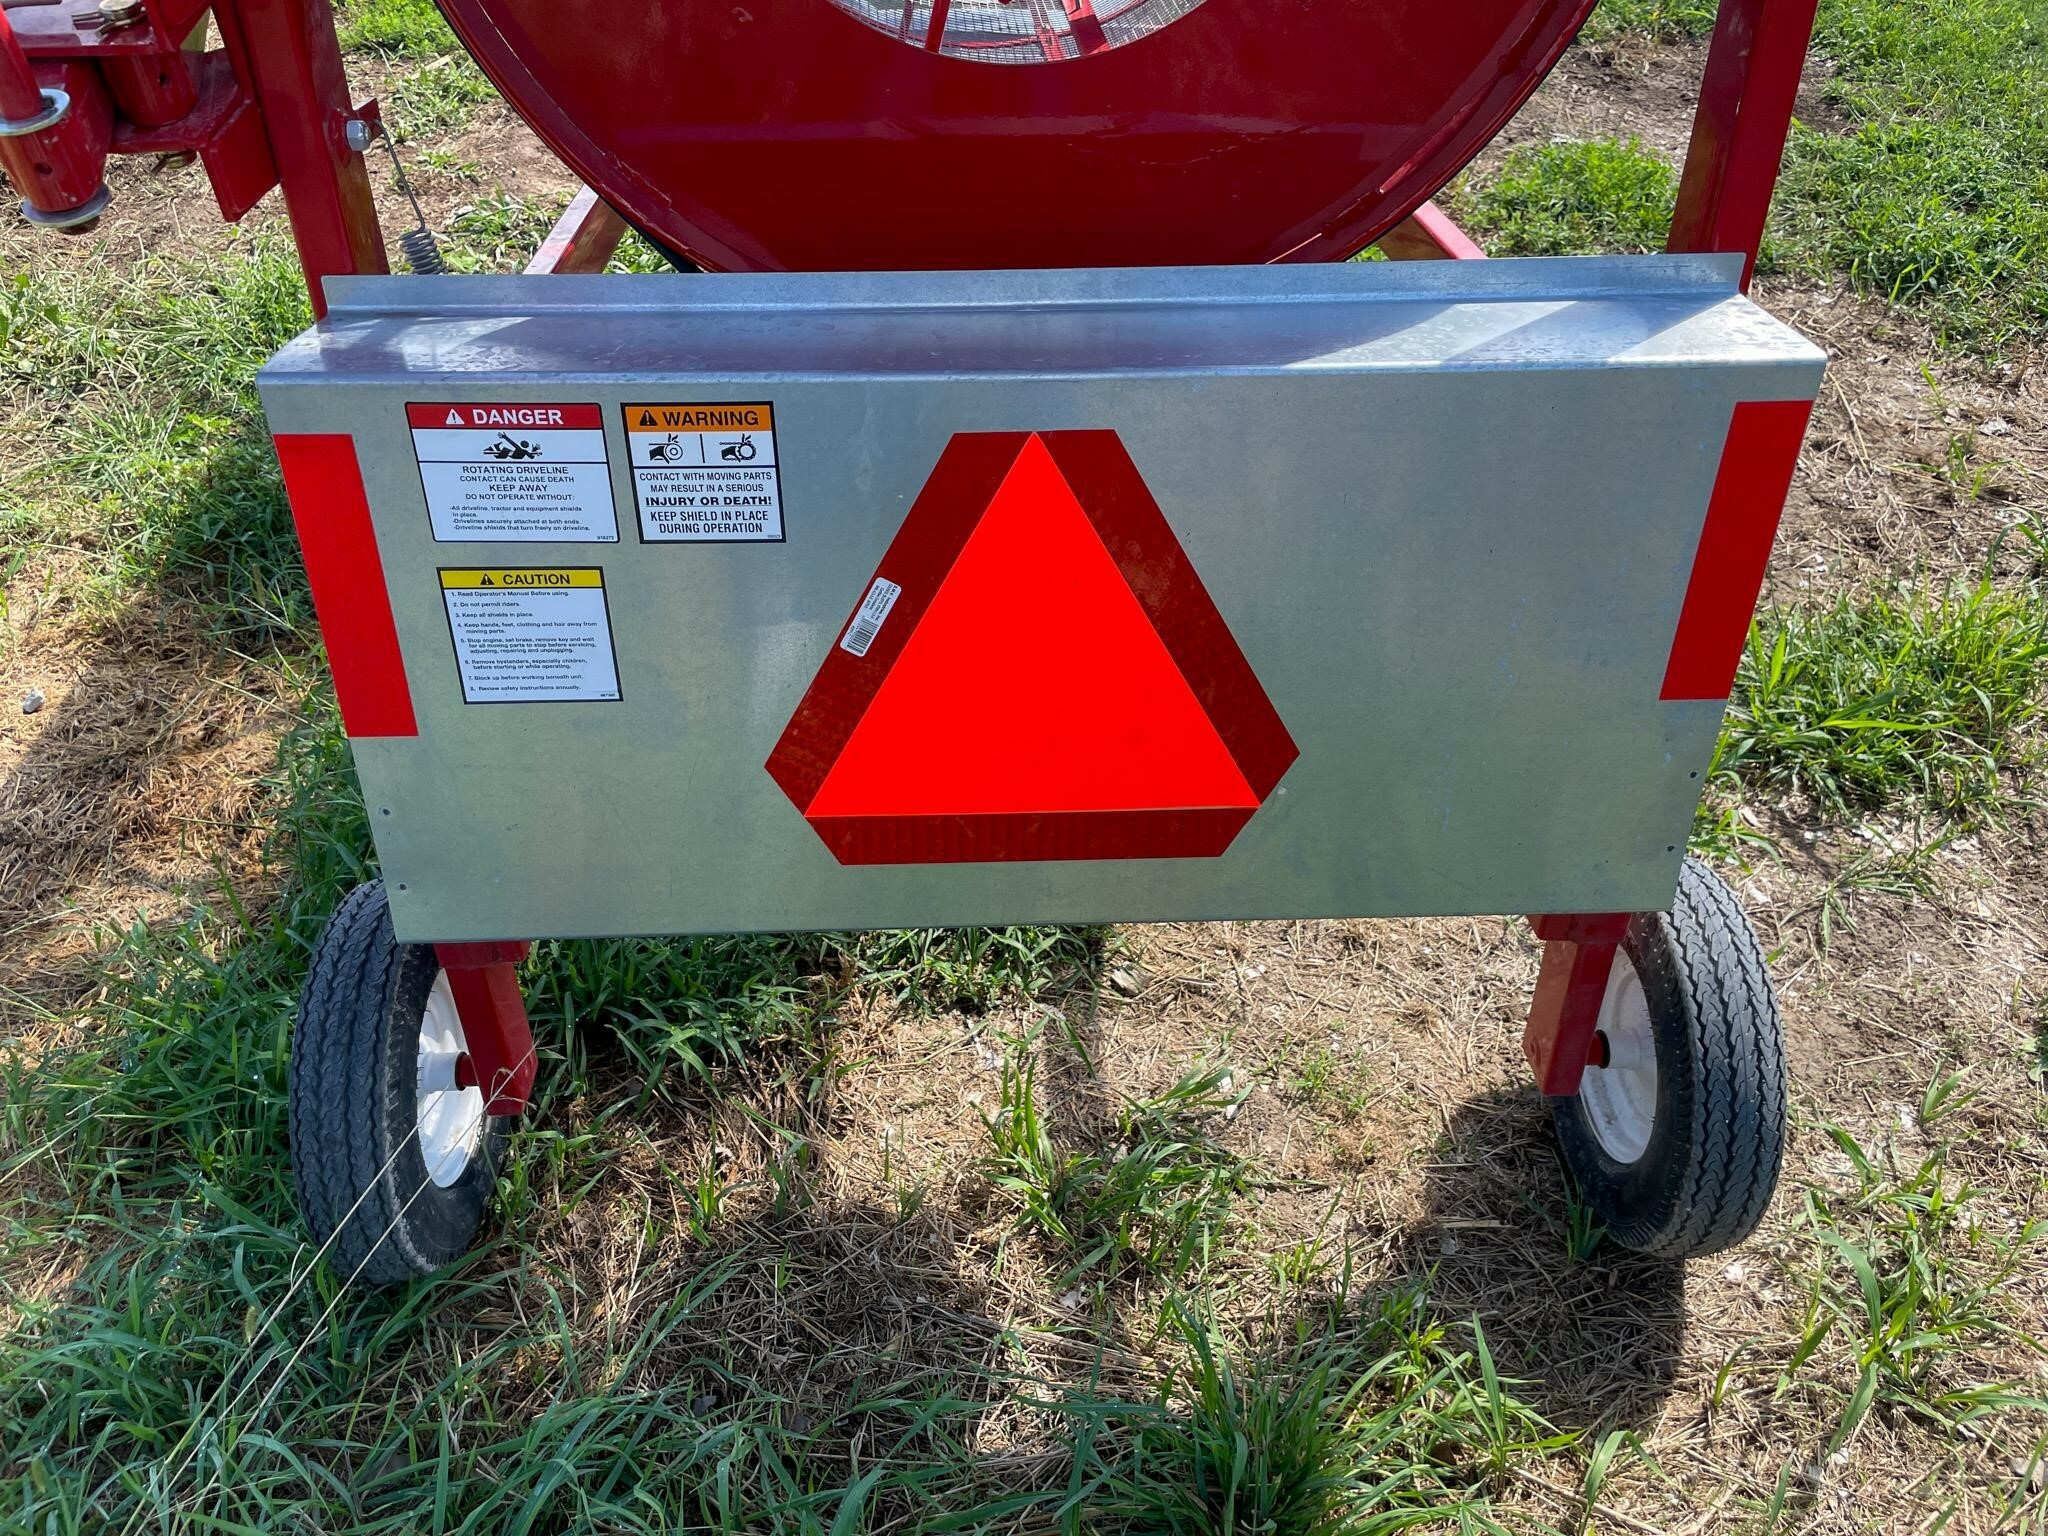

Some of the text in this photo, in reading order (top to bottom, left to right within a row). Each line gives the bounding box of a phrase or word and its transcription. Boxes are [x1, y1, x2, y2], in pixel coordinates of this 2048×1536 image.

[472, 409, 564, 425] DANGER
[662, 410, 759, 426] WARNING
[462, 466, 569, 474] ROTATING DRIVELINE
[640, 473, 680, 481] CONTACT
[707, 472, 741, 480] MOVING
[743, 472, 772, 480] PARTS
[489, 484, 548, 492] KEEP AWAY
[650, 484, 764, 493] MAY RESULT IN A SERIOUS
[645, 496, 772, 506] INJURY OR DEATH!
[650, 510, 769, 521] KEEP SHIELD IN PLACE
[659, 523, 763, 534] DURING OPERATION
[503, 574, 571, 585] CAUTION
